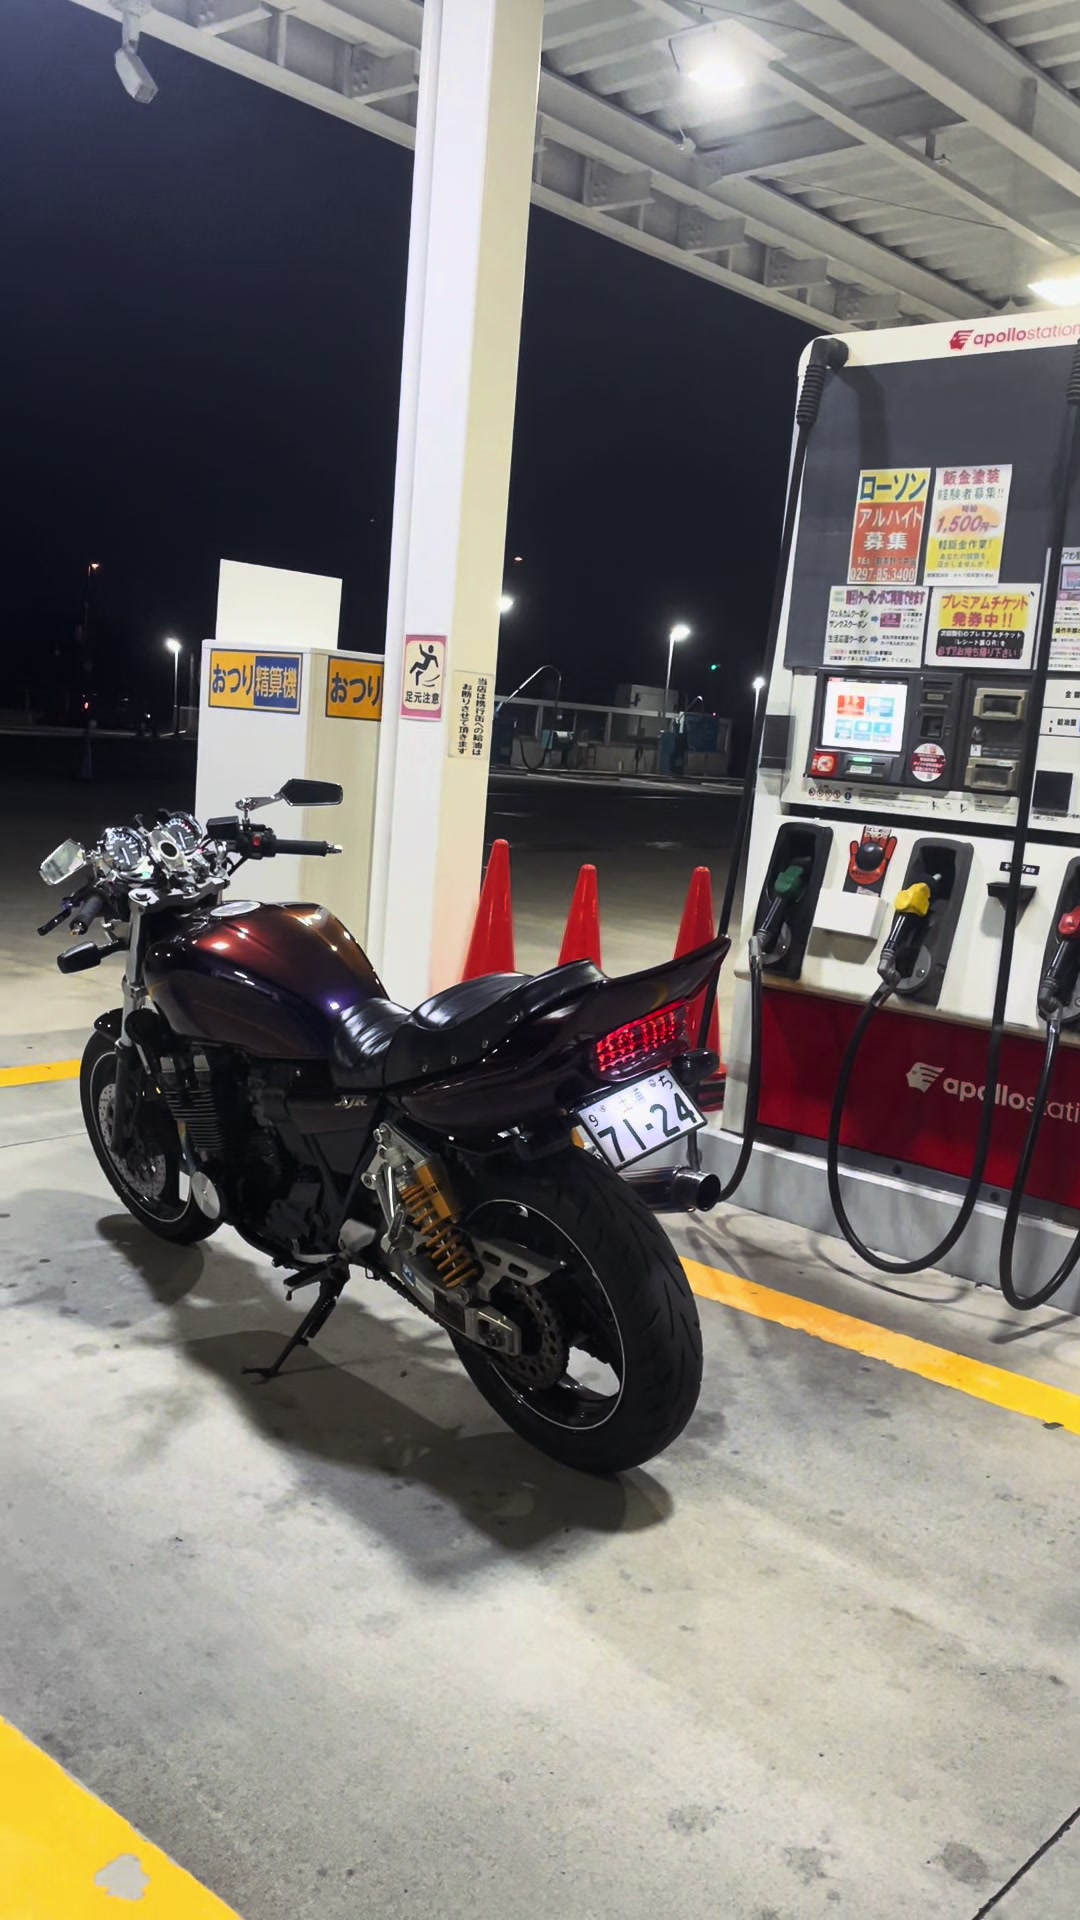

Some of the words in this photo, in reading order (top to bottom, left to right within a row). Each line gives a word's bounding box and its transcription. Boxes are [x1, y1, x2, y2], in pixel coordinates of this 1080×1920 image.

[860, 473, 926, 501] ローソン
[943, 468, 1000, 486] 鈑金塗装
[864, 531, 908, 551] 募集
[941, 594, 1028, 611] プレミアムチケット
[212, 663, 297, 699] おつり精算機
[330, 672, 381, 706] おつり
[405, 691, 440, 705] 足元注意
[457, 683, 473, 755] お断りさせて頂きます
[657, 1075, 673, 1090] ち
[597, 1092, 697, 1162] 71-24
